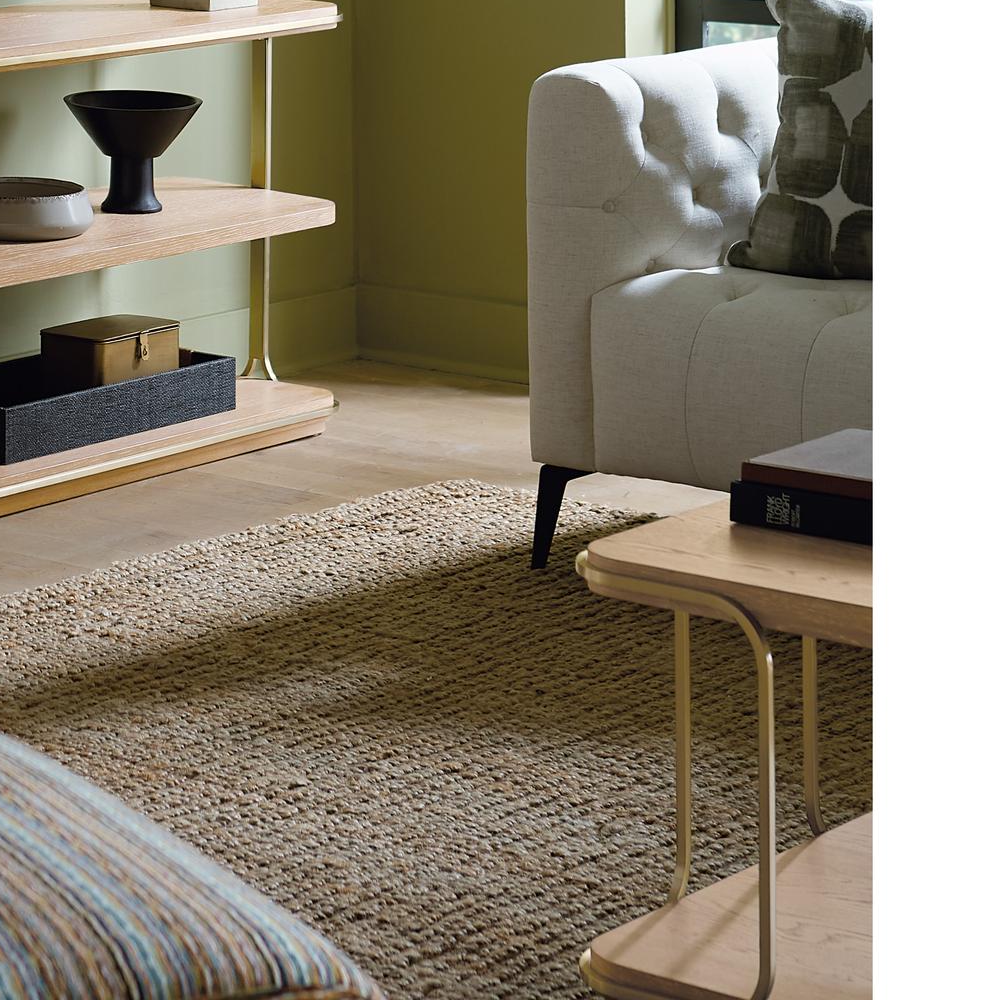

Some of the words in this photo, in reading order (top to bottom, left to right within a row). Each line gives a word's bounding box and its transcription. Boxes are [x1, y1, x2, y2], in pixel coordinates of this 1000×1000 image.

[766, 496, 775, 522] FRANK
[774, 498, 782, 524] LLOYD
[782, 492, 790, 525] WRIGHT
